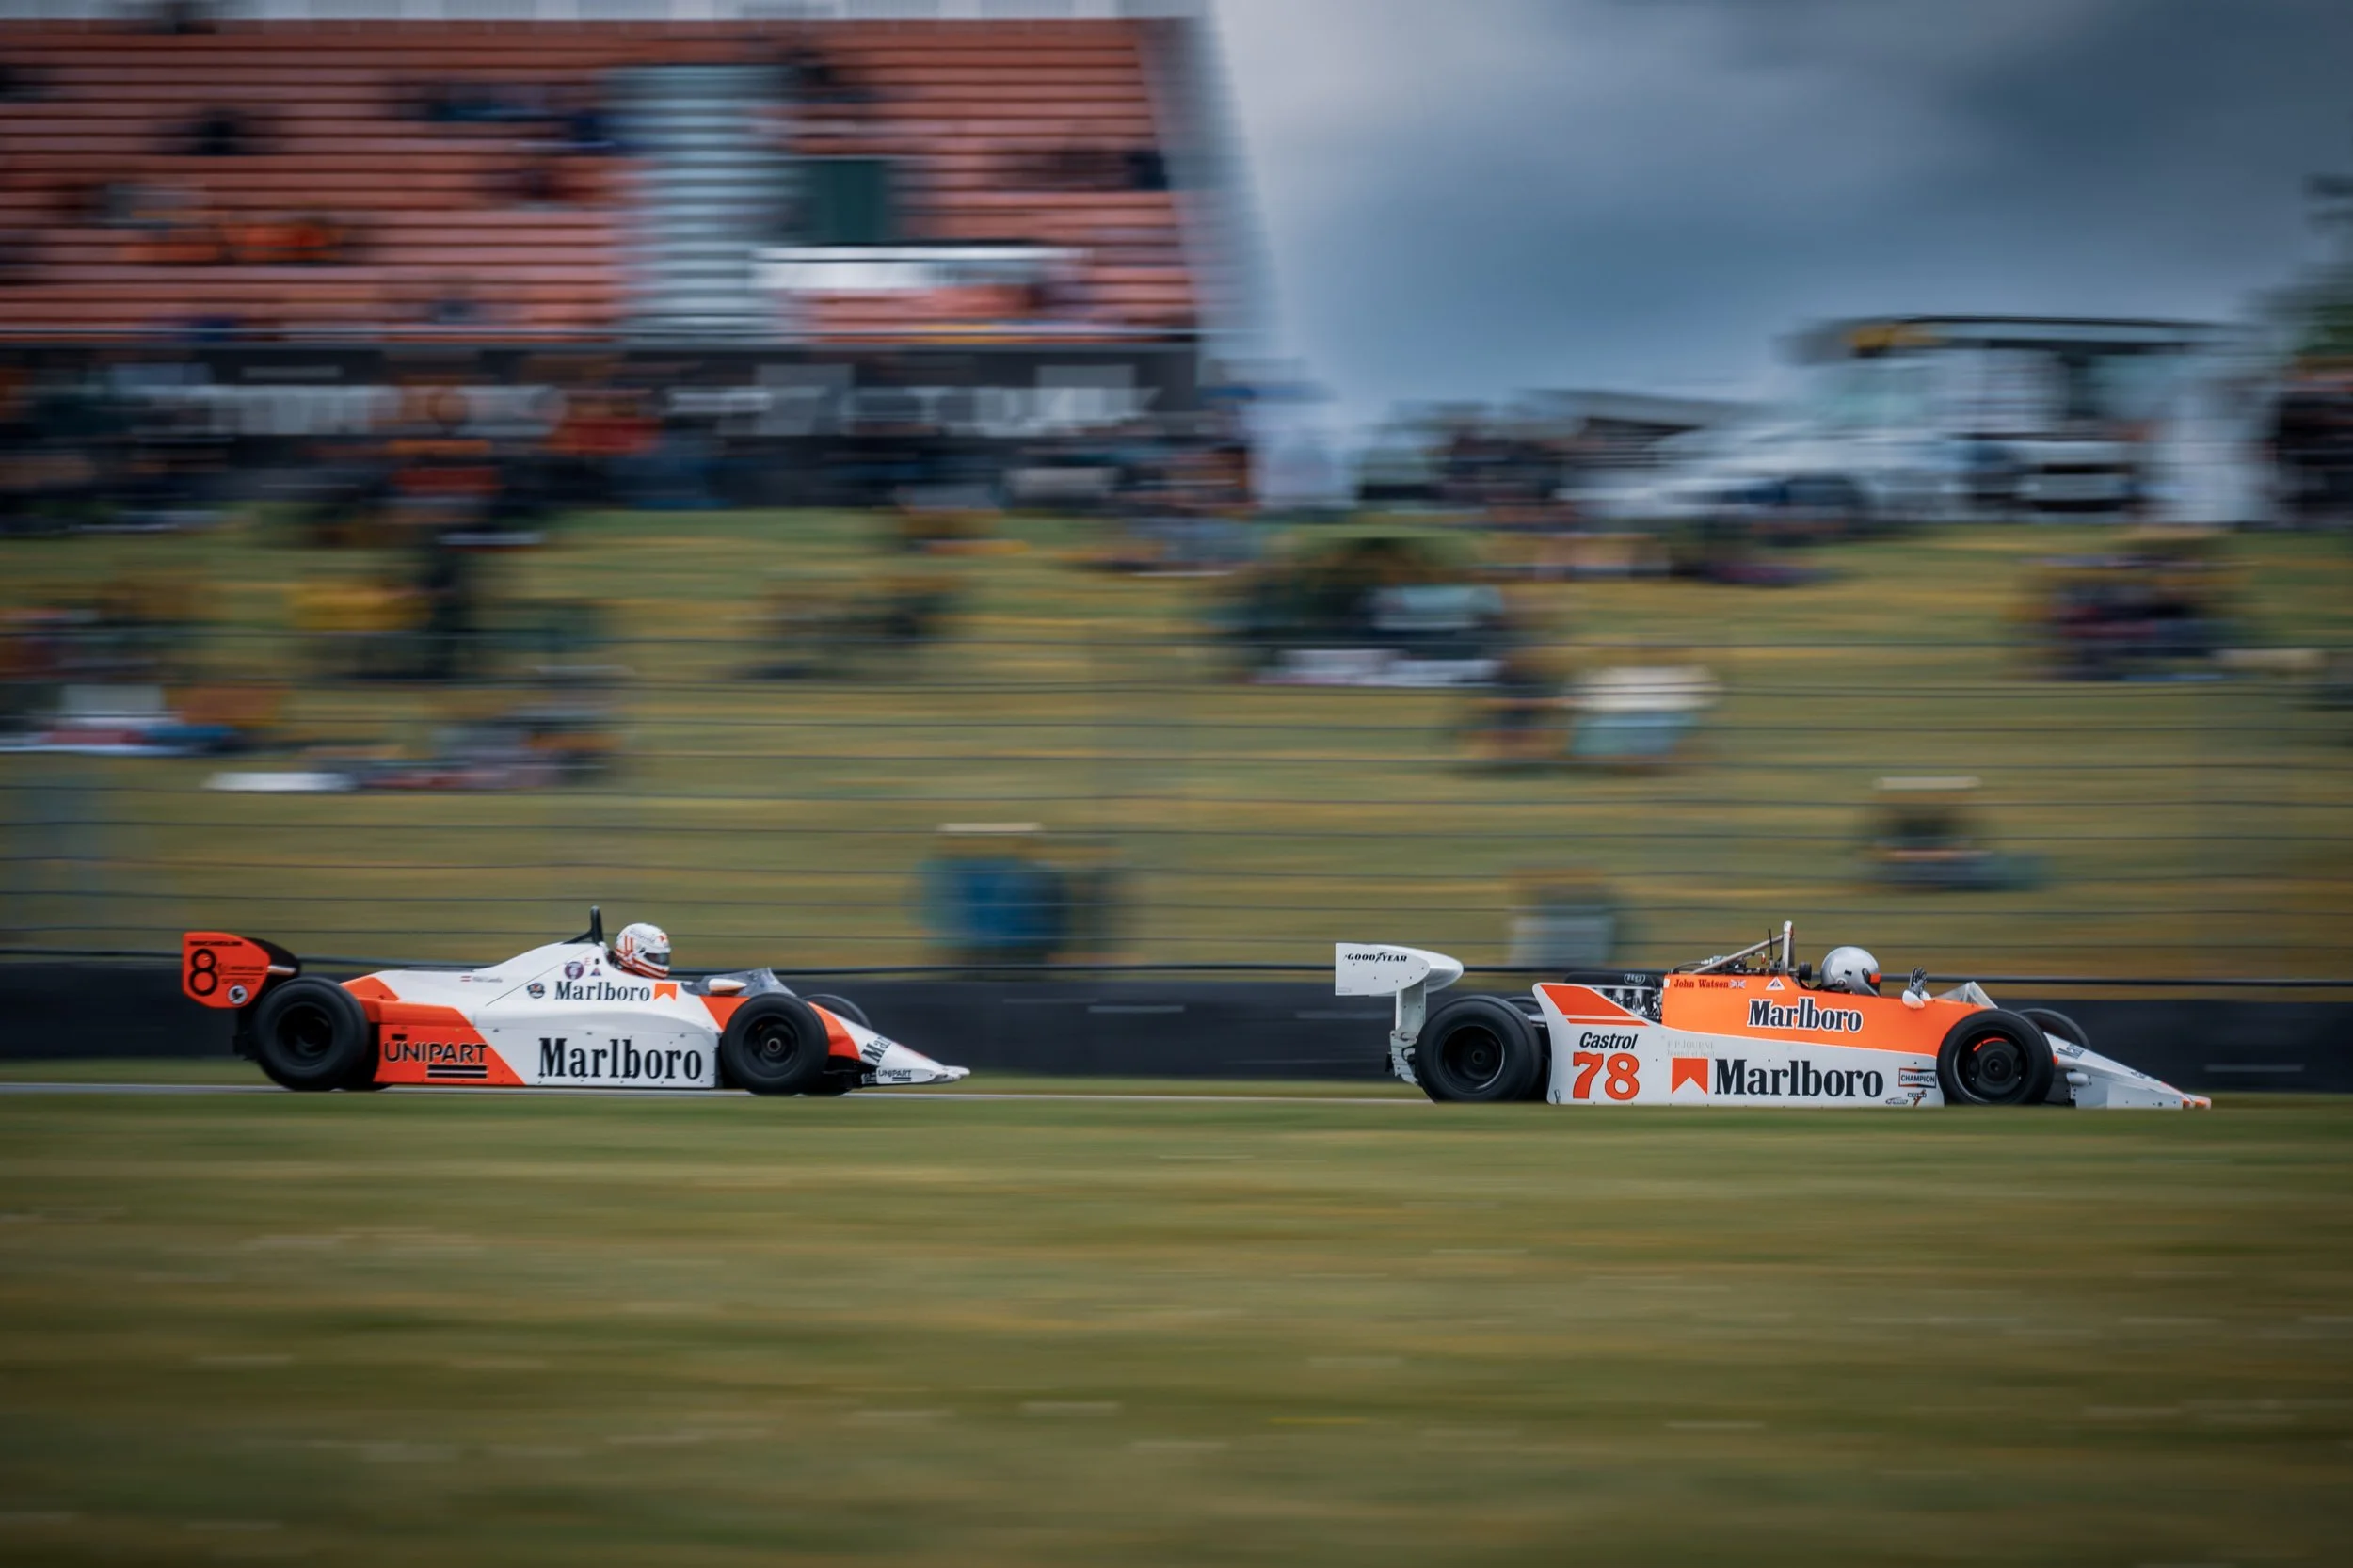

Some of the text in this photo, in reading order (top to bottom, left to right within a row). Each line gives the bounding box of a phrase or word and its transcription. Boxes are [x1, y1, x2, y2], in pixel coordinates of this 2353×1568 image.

[1347, 952, 1407, 963] GOODYEAR
[189, 948, 218, 997] 8
[554, 981, 650, 1001] Marlboro
[1674, 979, 1729, 988] John Watson
[1748, 999, 1863, 1032] Marlboro
[1579, 1032, 1639, 1049] Castrol
[384, 1042, 488, 1062] UNIPART
[538, 1037, 702, 1080] Marlboro
[1573, 1051, 1640, 1100] 78
[1714, 1058, 1884, 1098] Marlboro
[1901, 1074, 1935, 1082] CHAMPION
